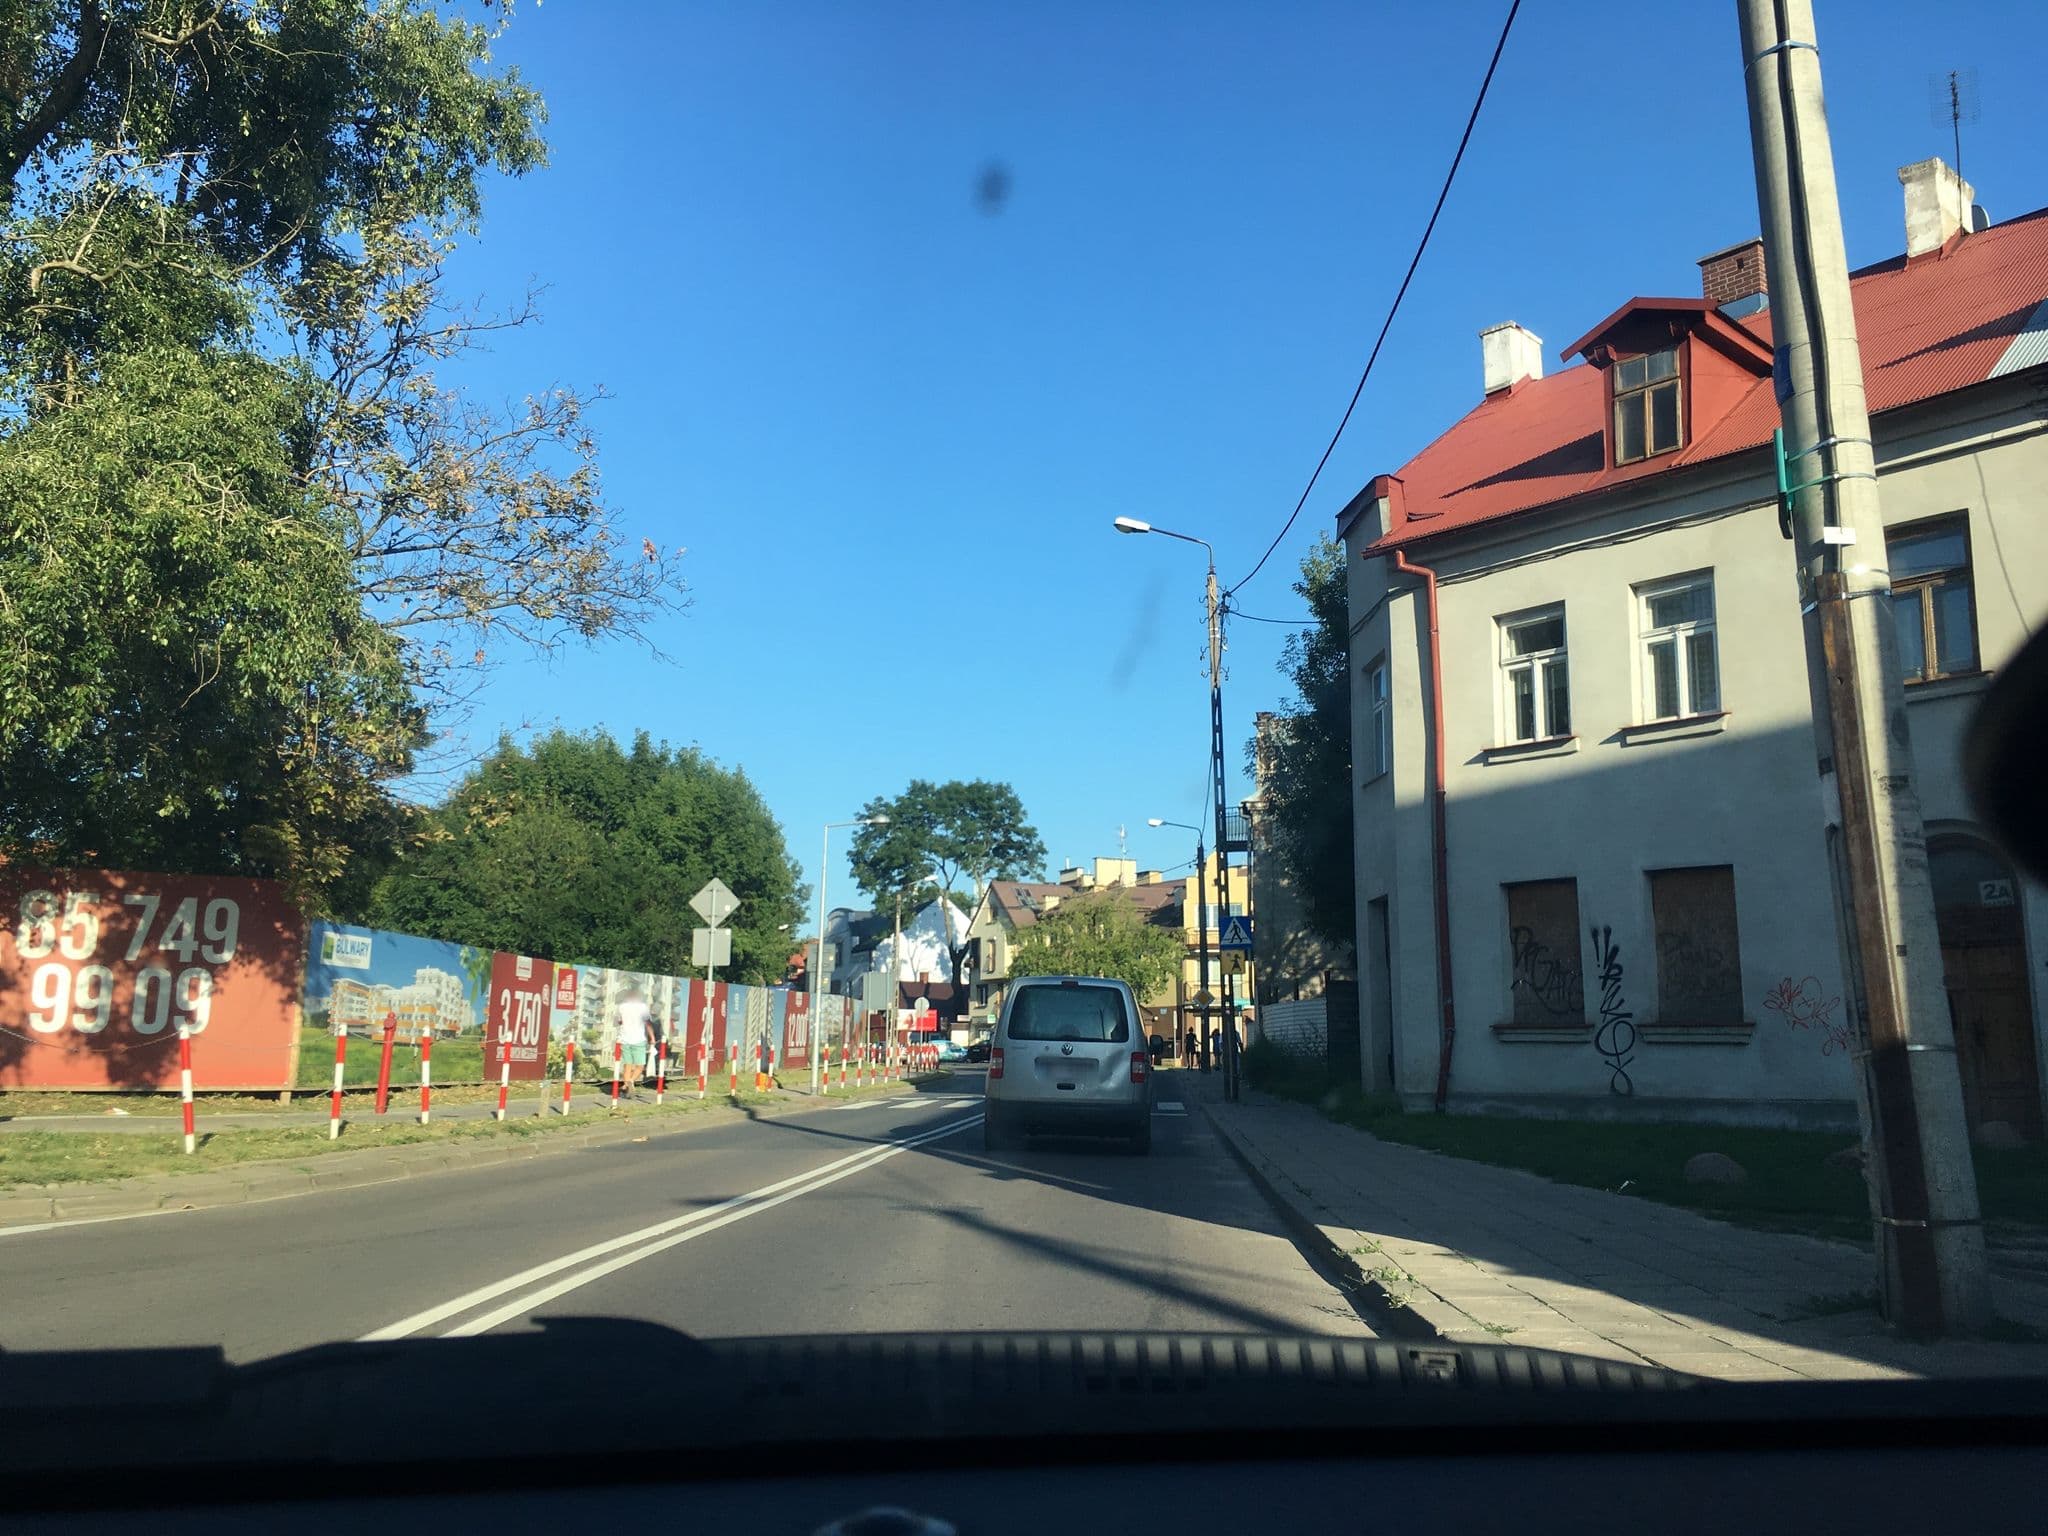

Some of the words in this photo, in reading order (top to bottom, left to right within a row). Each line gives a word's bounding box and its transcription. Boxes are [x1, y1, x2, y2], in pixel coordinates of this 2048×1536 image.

[15, 889, 101, 961] 85
[123, 894, 241, 964] 749
[29, 963, 114, 1034] 99
[131, 966, 214, 1035] 09
